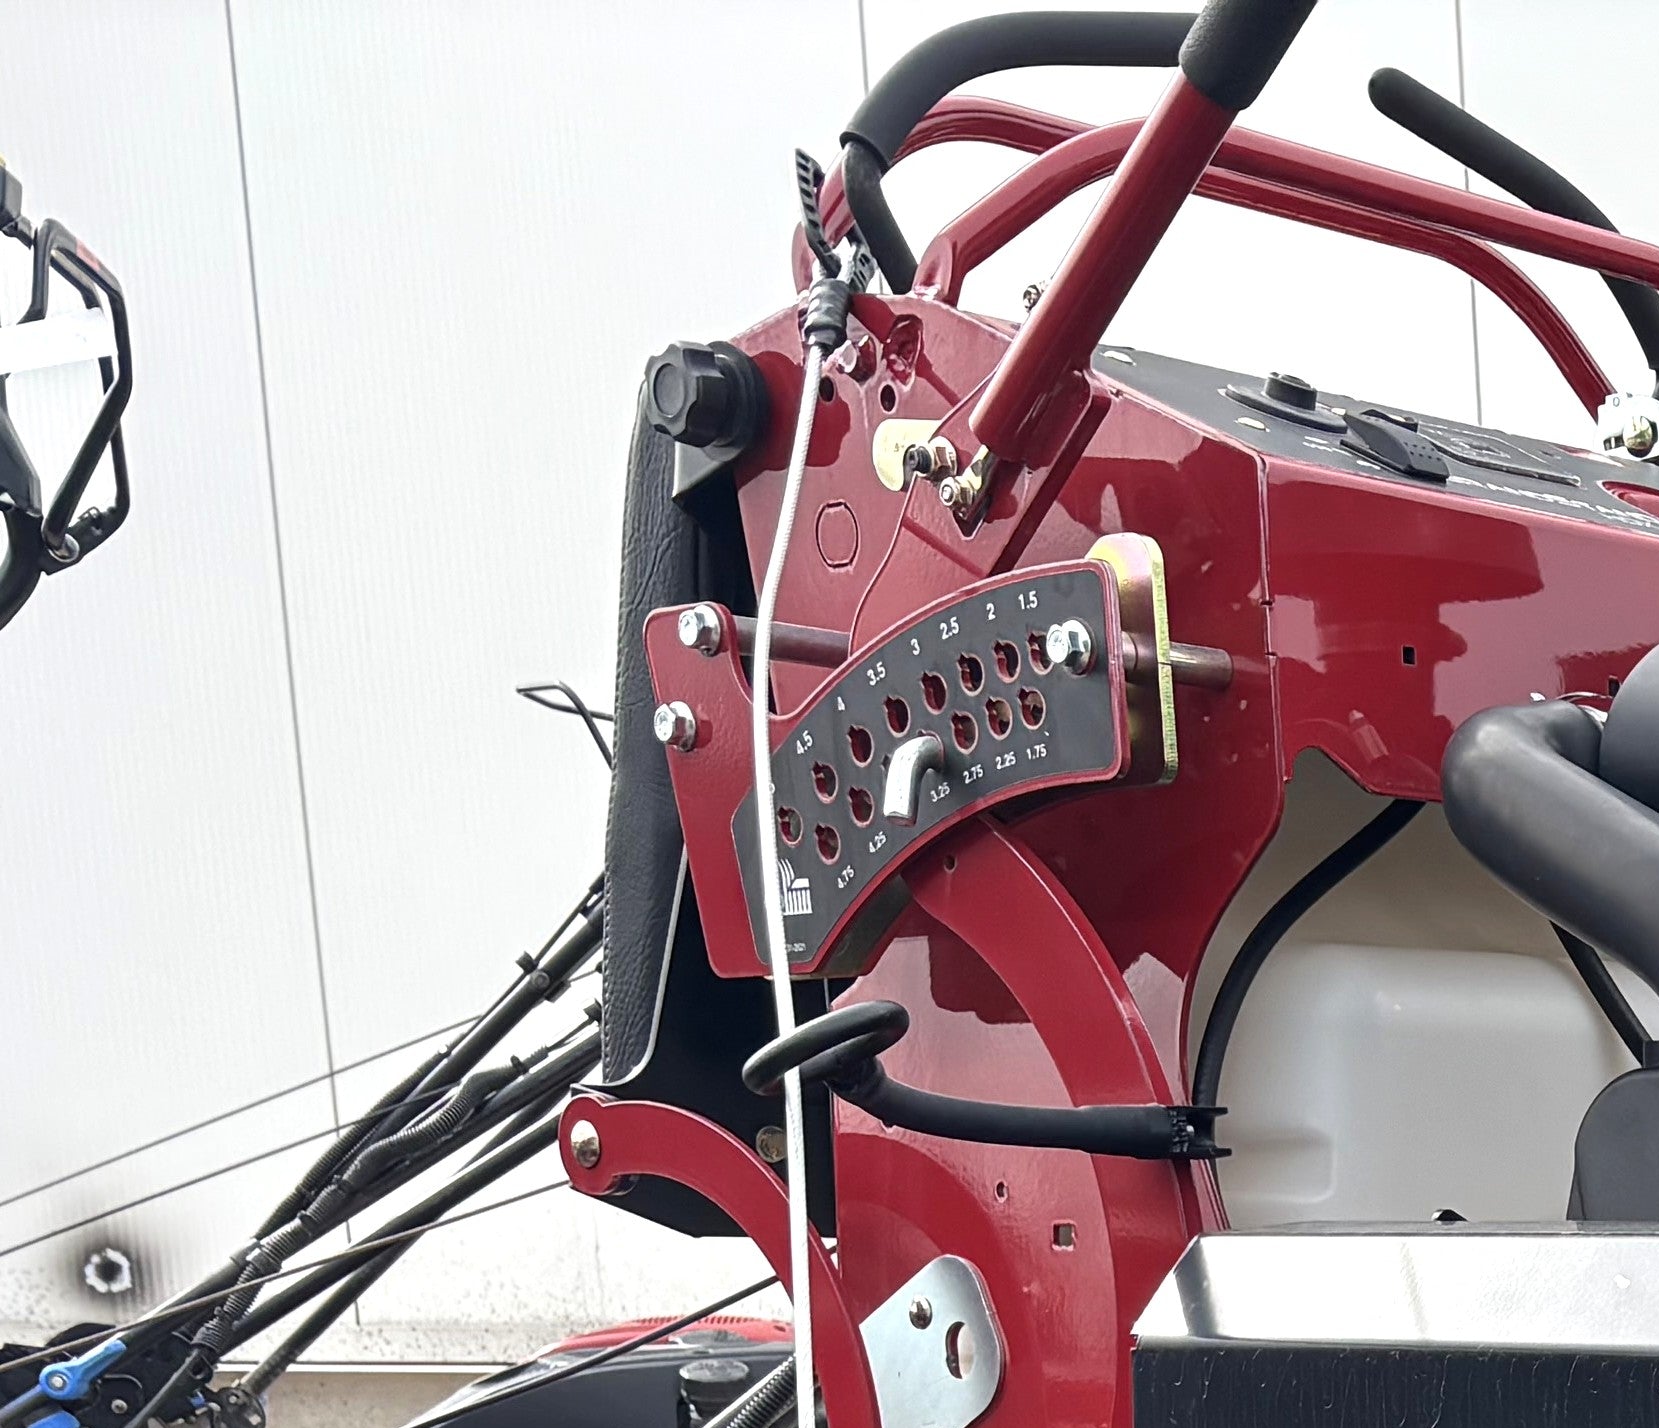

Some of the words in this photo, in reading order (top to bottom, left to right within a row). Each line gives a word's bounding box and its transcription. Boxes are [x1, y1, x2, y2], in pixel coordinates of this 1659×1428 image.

[1018, 591, 1038, 610] 1.5
[986, 603, 996, 620] 2
[940, 617, 960, 640] 2.5
[910, 638, 920, 655] 3
[867, 661, 886, 686] 3.5
[837, 696, 846, 711] 4
[796, 730, 813, 755] 4.5
[1026, 744, 1047, 760] 1.75
[995, 751, 1017, 770] 2.25
[963, 764, 984, 784] 2.75
[930, 782, 951, 802] 3.25
[868, 831, 887, 853] 4.25
[837, 864, 855, 889] 4.75
